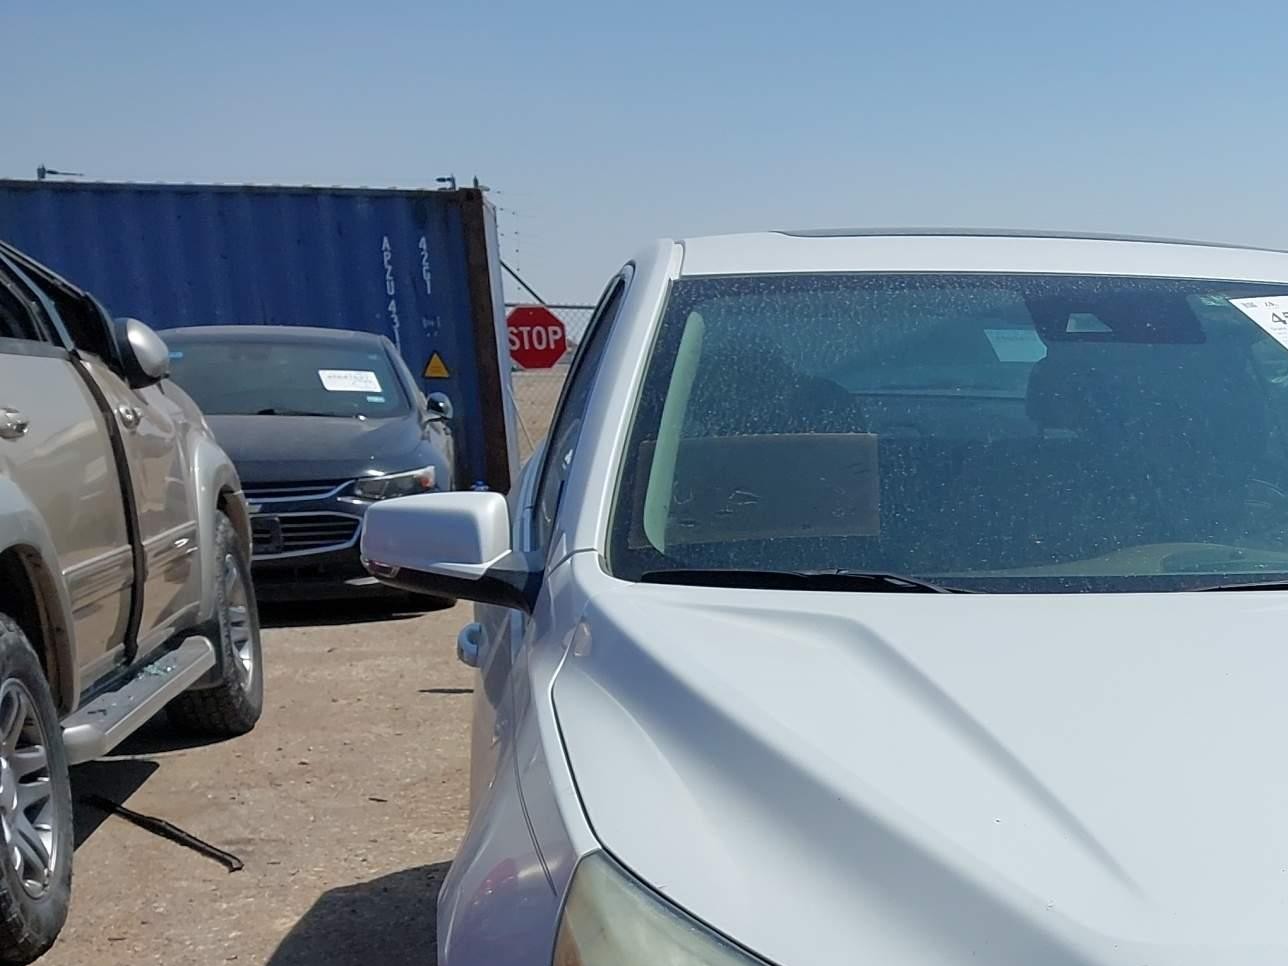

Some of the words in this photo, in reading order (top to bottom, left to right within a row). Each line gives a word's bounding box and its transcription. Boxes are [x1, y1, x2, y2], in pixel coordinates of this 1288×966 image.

[382, 235, 395, 295] APZU
[418, 236, 431, 294] 42G1
[508, 326, 562, 351] STOP
